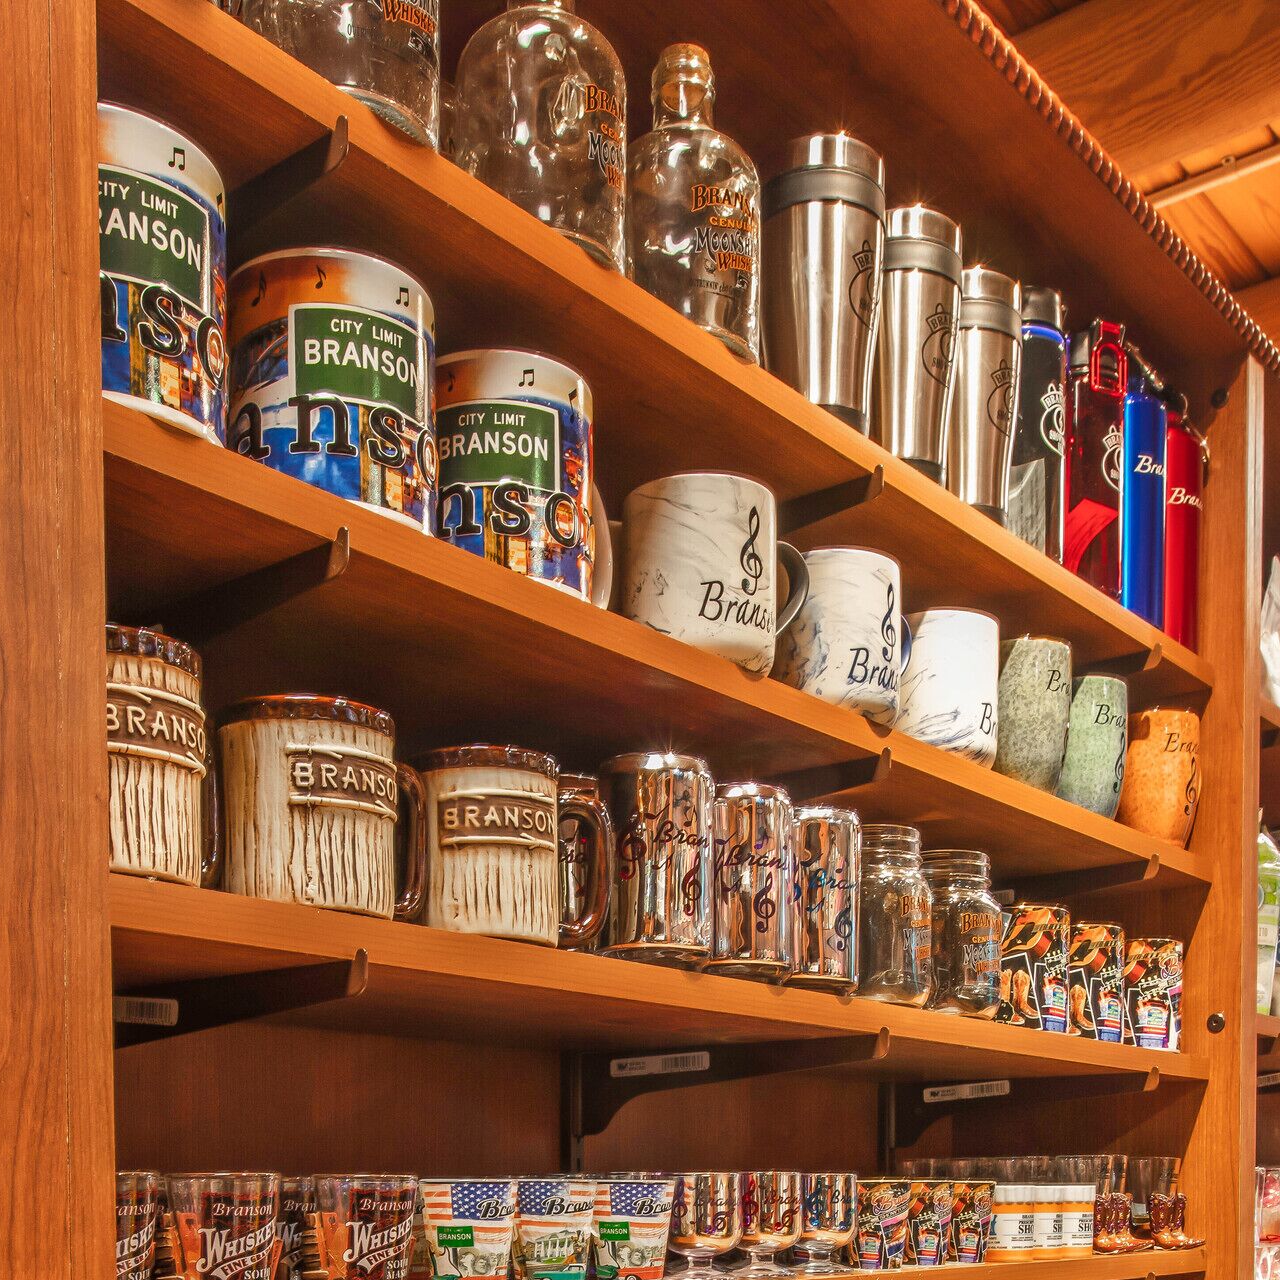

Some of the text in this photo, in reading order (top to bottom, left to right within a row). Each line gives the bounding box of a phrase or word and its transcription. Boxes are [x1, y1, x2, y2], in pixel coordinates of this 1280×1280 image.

[141, 190, 179, 219] LIMIT
[330, 318, 403, 348] CITY LIMIT
[304, 338, 420, 388] BRANSON
[458, 412, 526, 427] CITY LIMIT
[439, 432, 549, 462] BRANSON
[442, 806, 556, 835] BRANSON
[213, 1202, 272, 1216] Branson
[360, 1198, 413, 1211] Branson
[439, 1233, 472, 1241] BRANSON
[221, 1257, 249, 1280] FINE
[366, 1249, 392, 1267] FINE
